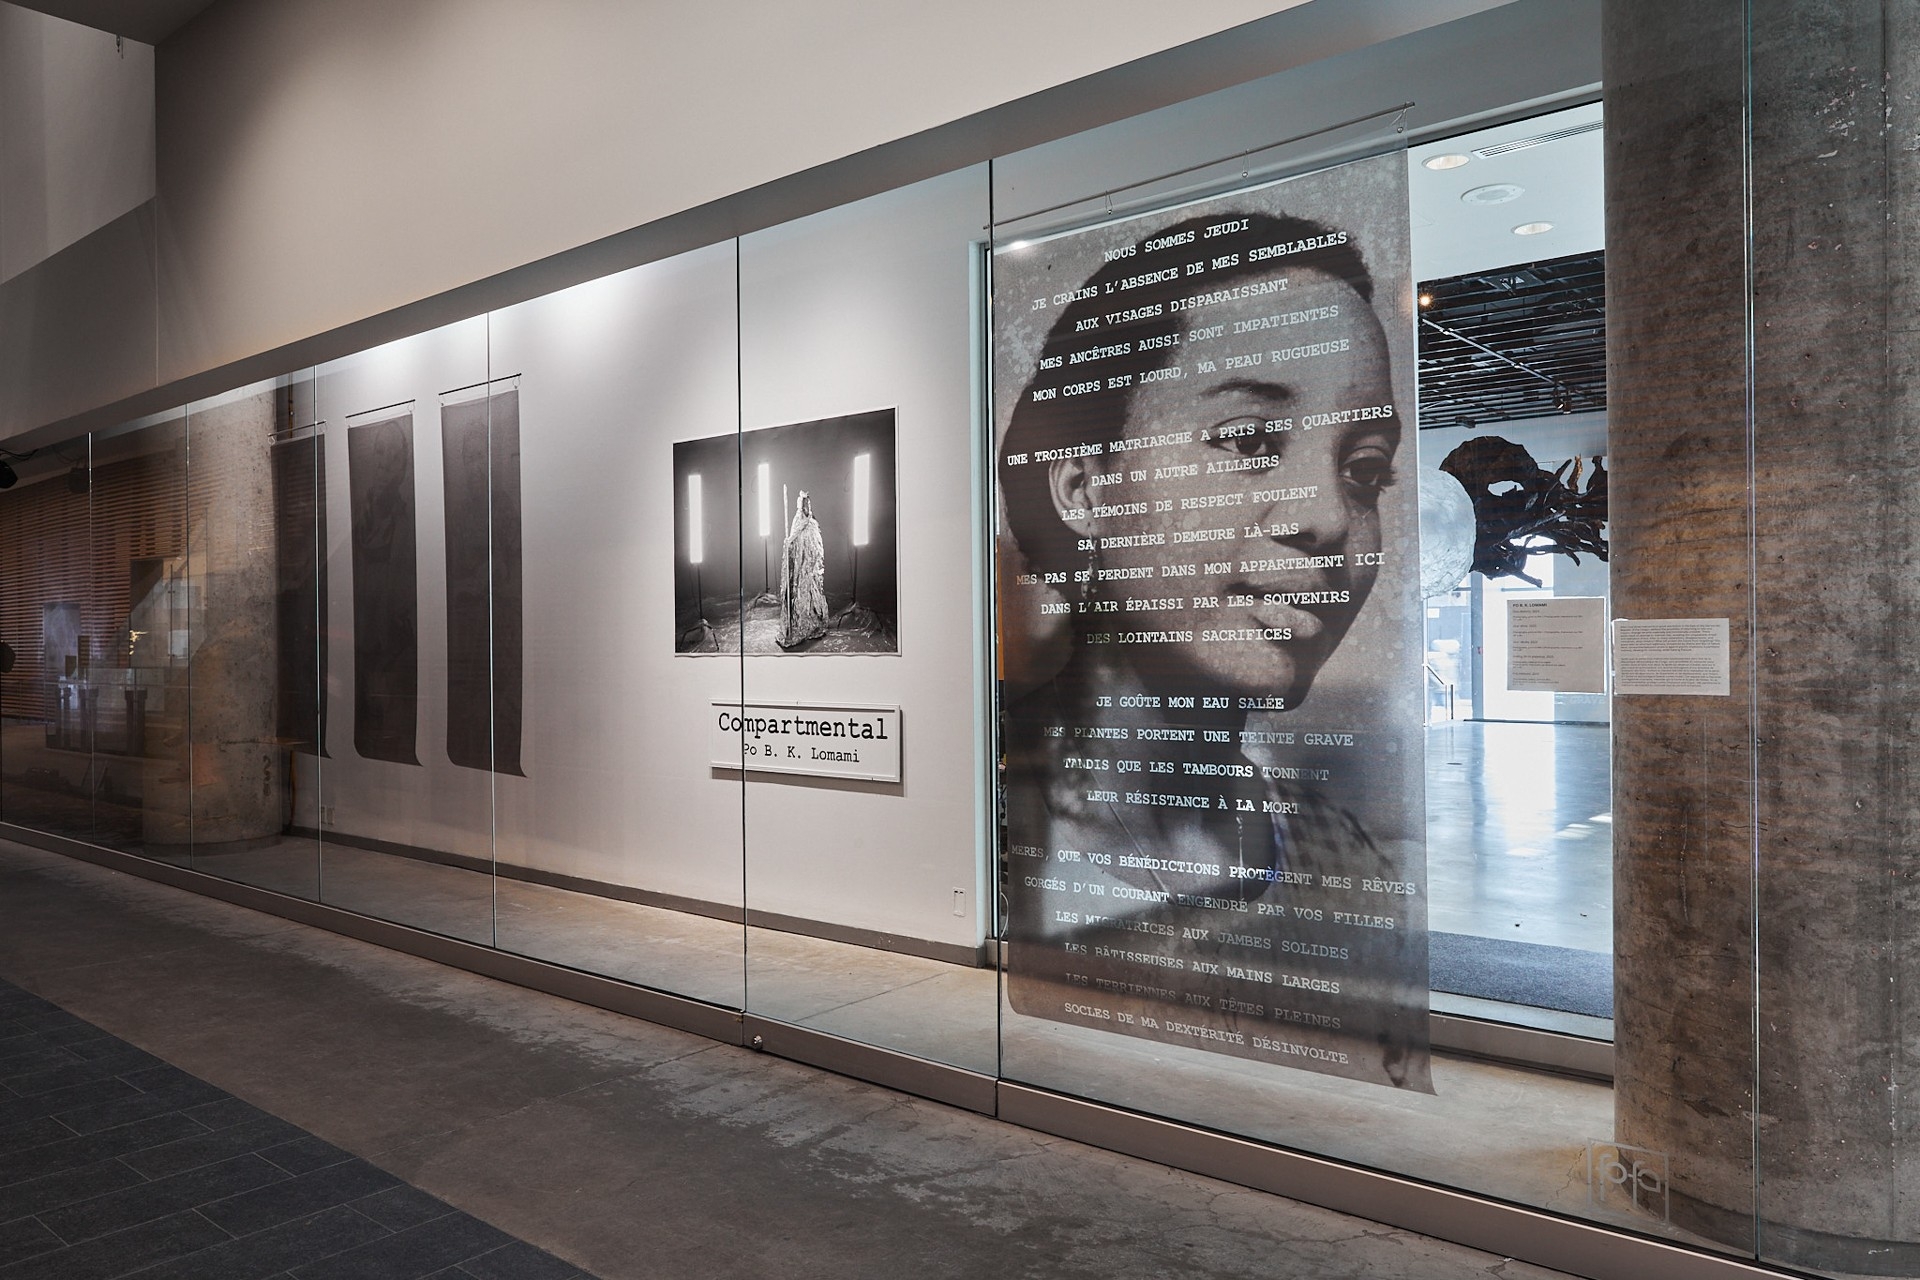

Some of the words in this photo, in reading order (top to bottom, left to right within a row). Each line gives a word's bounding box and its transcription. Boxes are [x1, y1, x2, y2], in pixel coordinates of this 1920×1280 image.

[1104, 246, 1136, 263] NOUS
[1145, 231, 1195, 254] SOMMES
[1203, 219, 1249, 240] JEUDI
[1032, 296, 1046, 310] JE
[1053, 286, 1097, 306] CRAINS
[1186, 260, 1203, 275] DE
[1211, 254, 1239, 271] MES
[1249, 231, 1347, 262] SEMBLABLES
[1075, 316, 1099, 332] AUX
[1105, 304, 1163, 325] VISAGES
[1170, 279, 1288, 313] DISPARAISSANT
[1040, 356, 1062, 370] MES
[1069, 341, 1130, 364] ANCÊTRES
[1139, 334, 1179, 351] AUSSI
[1189, 325, 1223, 342] SONT
[1233, 305, 1339, 333] IMPATIENTES
[1032, 388, 1056, 401] MON
[1063, 380, 1100, 397] CORPS
[1108, 374, 1132, 389] EST
[1140, 366, 1187, 384] LOURD,
[1197, 360, 1216, 374] MA
[1226, 354, 1262, 369] PEAU
[1271, 340, 1349, 363] RUGUEUSE
[1007, 454, 1027, 466] UNE
[1035, 442, 1103, 462] TROISIÈME
[1109, 432, 1192, 452] MATRIARCHE
[1200, 428, 1211, 441] A
[1219, 424, 1255, 439] PRIS
[1265, 419, 1292, 433] SES
[1302, 405, 1392, 430] QUARTIERS
[1091, 474, 1122, 486] DANS
[1130, 471, 1147, 482] UN
[1154, 465, 1197, 480] AUTRE
[1206, 456, 1279, 475] AILLEURS
[1062, 509, 1085, 520] LES
[1093, 501, 1147, 518] TÉMOINS
[1155, 500, 1173, 512] DE
[1181, 494, 1244, 510] RESPECT
[1253, 486, 1317, 502] FOULENT
[1078, 539, 1094, 551] SA
[1100, 531, 1165, 548] DERNIÈRE
[1174, 528, 1234, 543] DEMEURE
[1244, 522, 1299, 537] LÀ-BAS
[1016, 574, 1037, 585] MES
[1044, 572, 1067, 583] PAS
[1074, 570, 1090, 582] SE
[1098, 566, 1154, 581] PERDENT
[1161, 563, 1196, 577] DANS
[1204, 561, 1232, 574] MON
[1239, 555, 1343, 573] APPARTEMENT
[1355, 553, 1385, 565] ICI
[1041, 603, 1071, 615] DANS
[1126, 595, 1183, 611] ÉPAISSI
[1192, 597, 1219, 609] PAR
[1227, 595, 1254, 607] LES
[1263, 591, 1349, 606] SOUVENIRS
[1087, 633, 1110, 644] DES
[1118, 630, 1193, 643] LOINTAINS
[1202, 628, 1292, 641] SACRIFICES
[1096, 697, 1112, 708] JE
[1119, 694, 1160, 708] GOÛTE
[1168, 697, 1194, 708] MON
[1202, 697, 1229, 709] EAU
[1238, 694, 1284, 709] SALÉE
[719, 713, 888, 740] Compartmental
[1044, 727, 1065, 737] MES
[1074, 728, 1128, 740] PLANTES
[1137, 729, 1195, 743] PORTENT
[1203, 731, 1229, 743] UNE
[1239, 731, 1294, 745] TEINTE
[1304, 733, 1353, 746] GRAVE
[743, 744, 757, 755] Po
[765, 745, 777, 757] B.
[787, 746, 801, 758] K.
[812, 748, 860, 763] Lomami
[1064, 758, 1109, 771] TANDIS
[1117, 760, 1141, 773] QUE
[1149, 761, 1174, 773] LES
[1183, 762, 1253, 778] TAMBOURS
[1263, 767, 1329, 781] TONNENT
[1087, 789, 1118, 803] LEUR
[1126, 789, 1209, 809] RÉSISTANCE
[1218, 794, 1228, 810] À
[1236, 799, 1255, 812] LA
[1262, 801, 1299, 815] MORT
[1057, 849, 1081, 864] QUE
[1088, 853, 1112, 866] VOS
[1119, 854, 1220, 876] BÉNÉDICTIONS
[1229, 865, 1312, 885] PROTÈGENT
[1321, 875, 1351, 890] MES
[1362, 876, 1416, 895] RÊVES
[1025, 875, 1066, 892] GORGÉS
[1112, 887, 1169, 903] COURANT
[1178, 894, 1248, 914] ENGENDRÉ
[1257, 903, 1285, 918] PAR
[1294, 907, 1322, 922] VOS
[1333, 911, 1395, 930] FILLES
[1056, 911, 1078, 924] LES
[1085, 914, 1174, 937] MIGRATRICES
[1182, 926, 1209, 941] AUX
[1218, 931, 1271, 950] JAMBES
[1281, 940, 1349, 960] SOLIDES
[1065, 942, 1087, 955] LES
[1095, 943, 1184, 970] BÂTISSEUSES
[1192, 962, 1219, 975] AUX
[1226, 966, 1272, 984] MAINS
[1282, 974, 1339, 994] LARGES
[1066, 972, 1088, 986] LES
[1096, 978, 1176, 1001] TERRIENNES
[1185, 989, 1210, 1007] AUX
[1219, 996, 1264, 1016] TÊTES
[1274, 1009, 1341, 1029] PLEINES
[1064, 1002, 1110, 1020] SOCLES
[1118, 1012, 1134, 1025] DE
[1141, 1016, 1159, 1030] MA
[1166, 1021, 1245, 1046] DEXTÉRITÉ
[1253, 1035, 1349, 1064] DÉSINVOLTE
